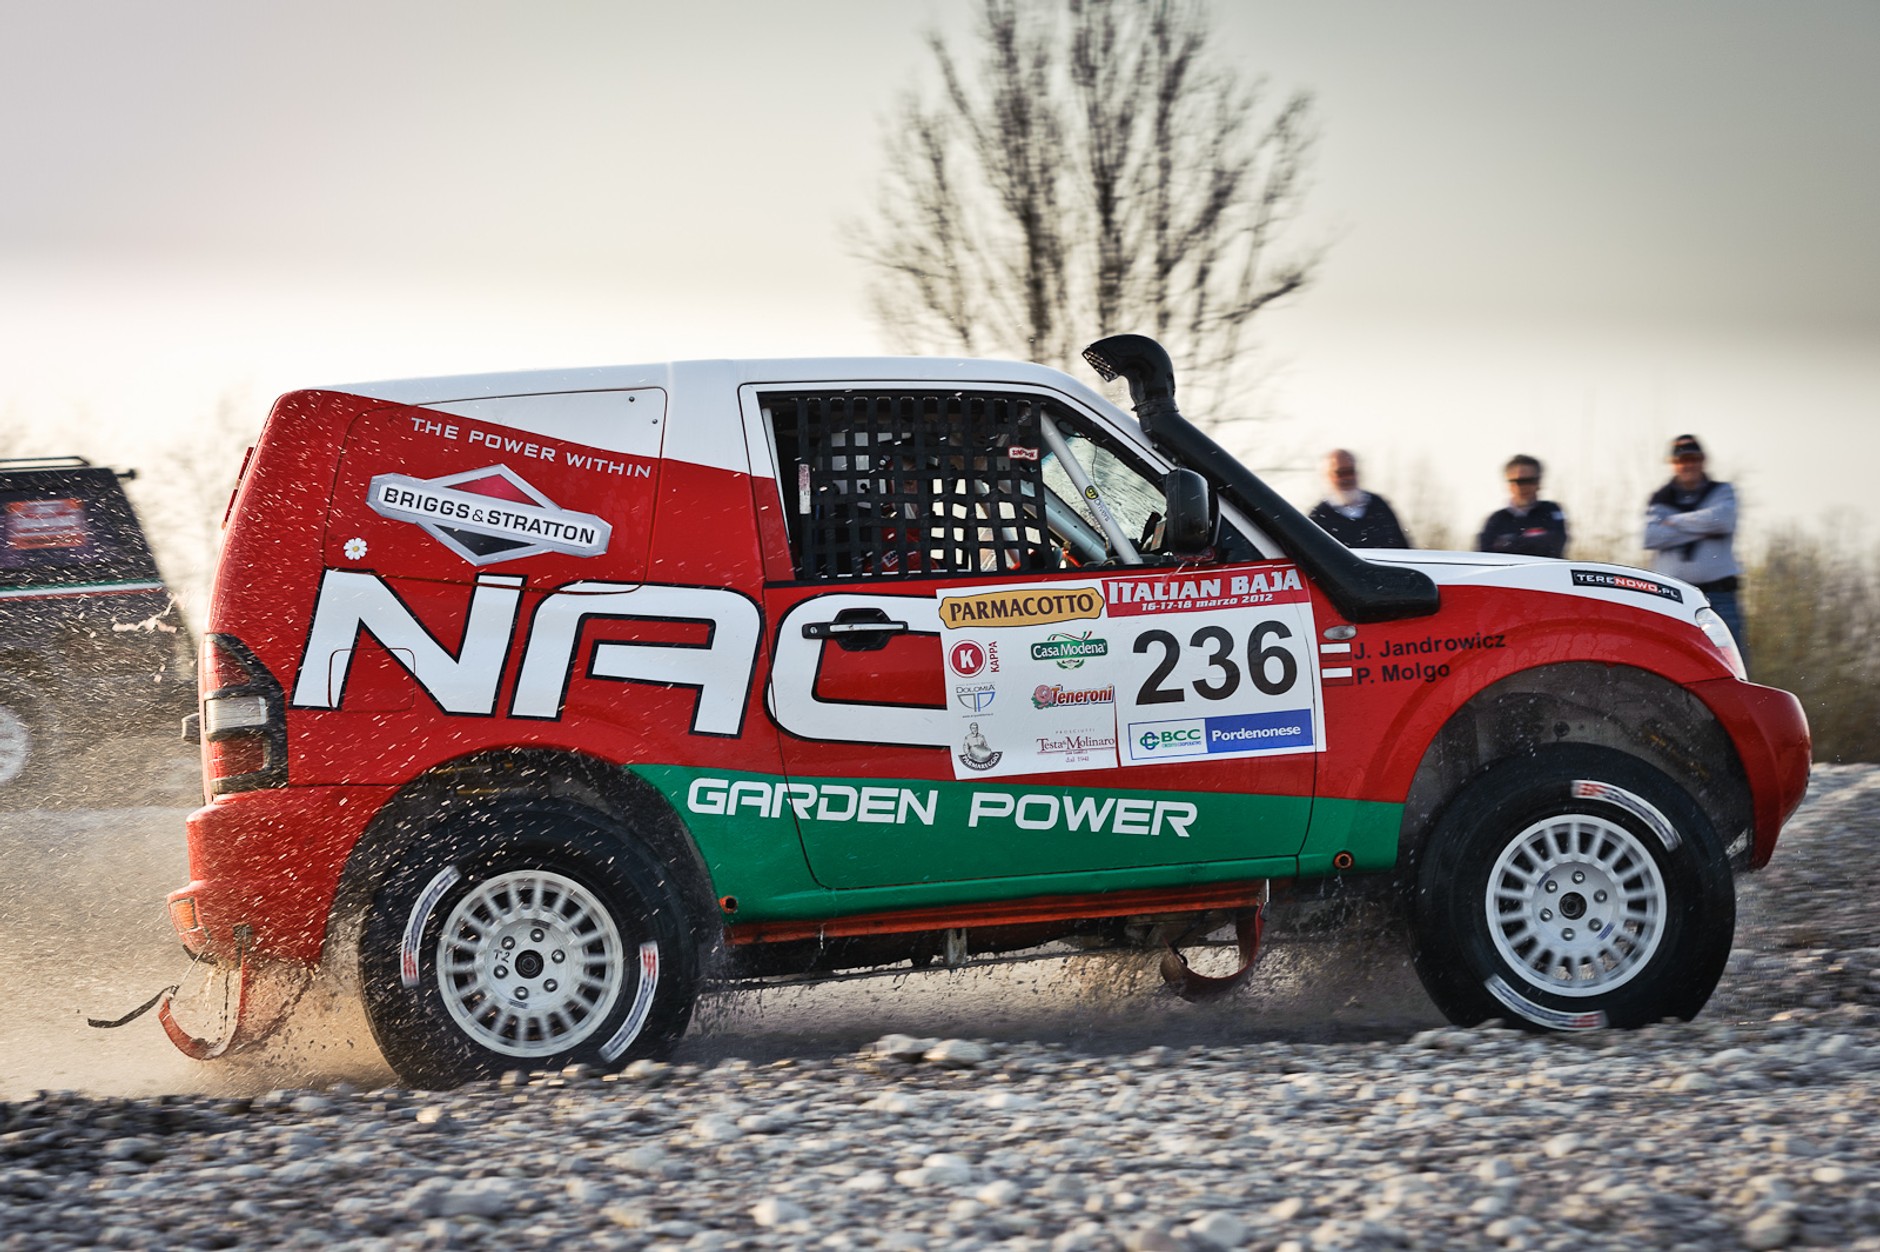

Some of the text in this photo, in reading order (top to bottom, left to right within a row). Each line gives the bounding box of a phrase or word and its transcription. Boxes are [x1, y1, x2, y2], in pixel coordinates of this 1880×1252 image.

[411, 417, 651, 479] THE POWER WITHIN
[1108, 569, 1303, 605] ITALIAN BAJA
[1576, 573, 1678, 598] TERENOWO.PL
[950, 593, 1094, 622] PARMACOTTO
[1142, 593, 1273, 612] 16-17-18 marzo 2012
[290, 568, 951, 748] NAC
[960, 649, 975, 669] K
[988, 641, 1000, 673] KAPPA
[1033, 641, 1105, 658] Casa Modena
[1353, 633, 1506, 661] J. Jandrowicz
[1133, 620, 1298, 706] 236
[1356, 663, 1450, 687] P. Molgo
[1051, 685, 1114, 705] Teneroni
[1161, 728, 1201, 743] BCC
[1212, 724, 1301, 742] Pordenonese
[687, 777, 1198, 838] GARDEN POWER
